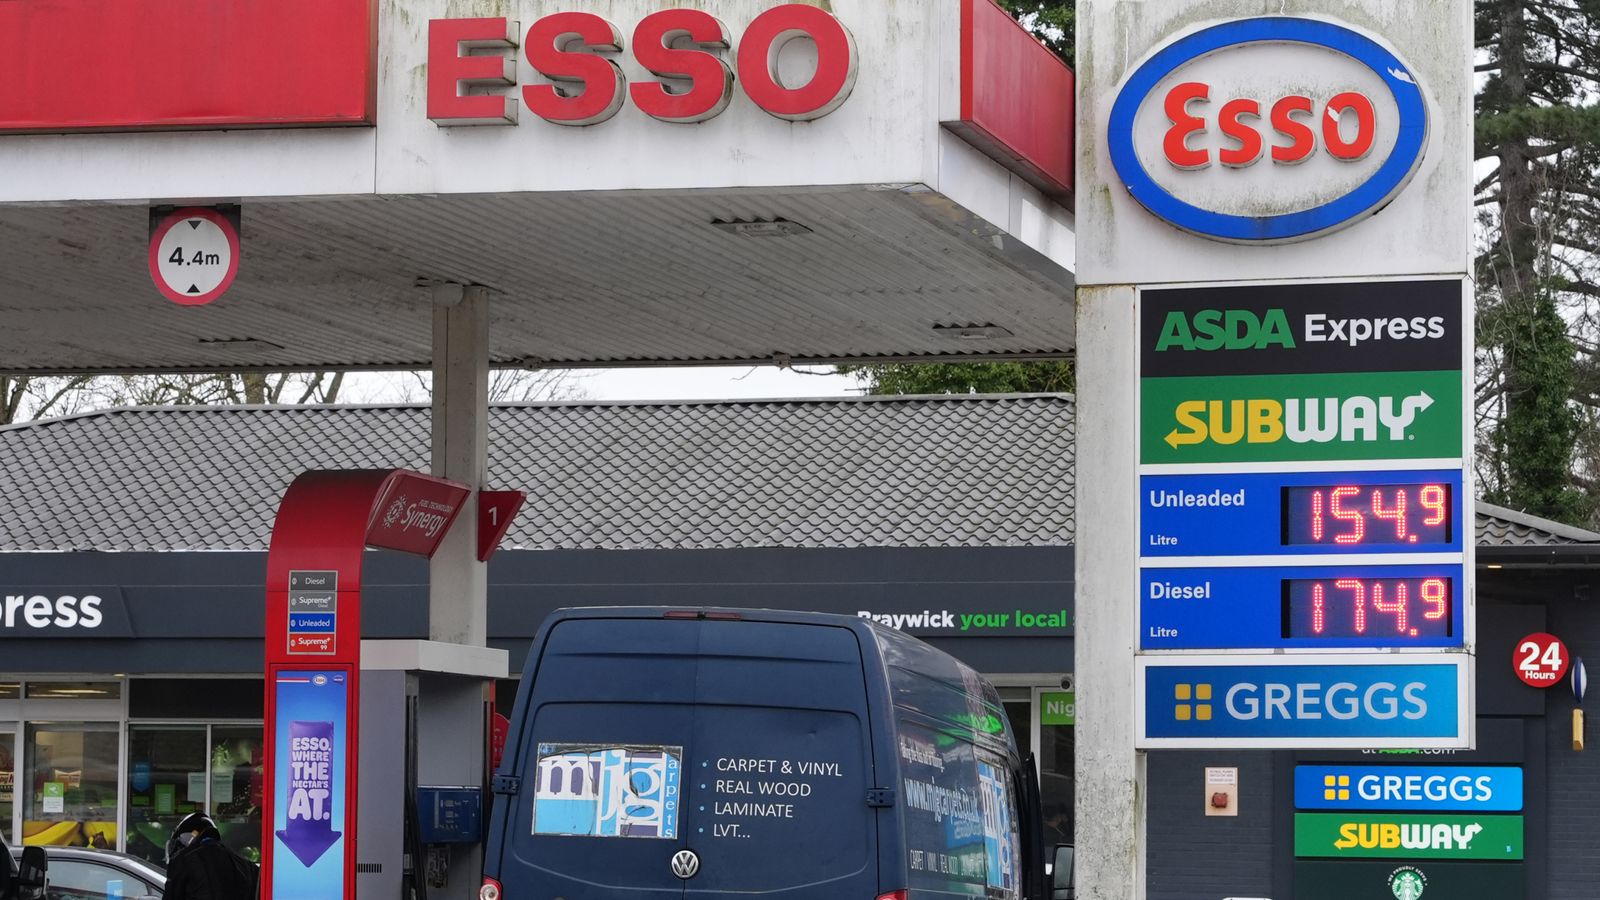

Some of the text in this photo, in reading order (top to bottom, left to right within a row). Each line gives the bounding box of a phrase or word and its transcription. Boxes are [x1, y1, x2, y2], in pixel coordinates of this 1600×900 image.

[427, 3, 855, 125] ESSO
[168, 246, 220, 266] 4.4m
[1155, 308, 1445, 351] ASDA Express
[1163, 390, 1435, 449] SUBWAY
[1150, 489, 1245, 508] Unleaded
[400, 503, 448, 537] Synergy
[487, 506, 497, 526] 1
[1310, 484, 1446, 544] 154.9
[1150, 534, 1178, 546] Litre
[305, 577, 326, 585] Diesel
[1150, 582, 1211, 600] Diesel
[0, 595, 103, 628] ress
[1310, 578, 1447, 636] 174.9
[298, 619, 331, 627] Unleaded
[960, 611, 1010, 631] your
[1015, 610, 1066, 627] local
[1150, 626, 1178, 638] Litre
[1519, 641, 1563, 671] 24
[1525, 670, 1556, 680] Hours
[1225, 682, 1428, 720] GREGGS
[292, 737, 331, 751] ESSO.
[292, 751, 330, 761] WHERE
[291, 761, 329, 780] THE
[716, 758, 843, 777] CARPET & VINYL
[292, 780, 329, 788] NECTAR'S
[715, 780, 811, 797] REAL WOOD
[1357, 775, 1492, 801] GREGGS
[288, 788, 330, 821] AT.
[714, 802, 794, 818] LAMINATE
[713, 824, 751, 838] LVT...
[1334, 822, 1483, 850] SUBWAY
